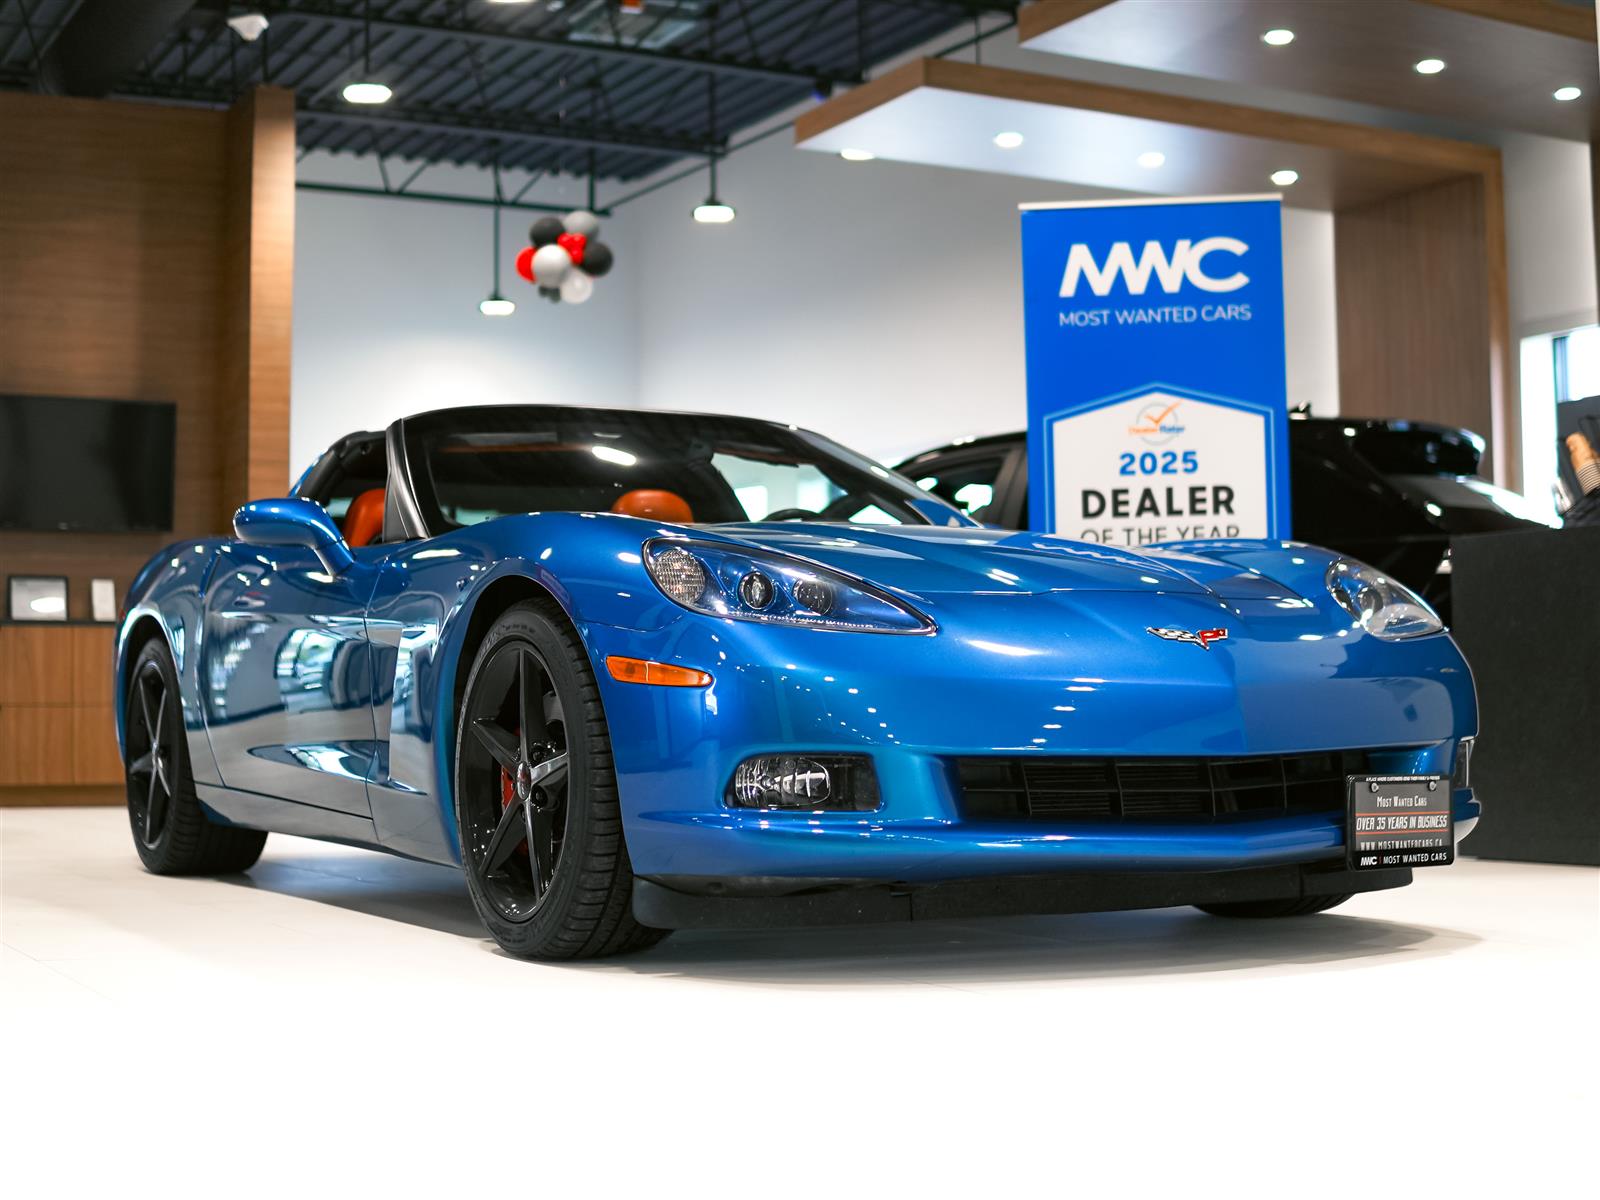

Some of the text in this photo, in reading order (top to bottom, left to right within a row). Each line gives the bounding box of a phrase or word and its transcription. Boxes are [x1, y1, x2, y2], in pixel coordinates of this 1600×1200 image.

[1059, 236, 1250, 298] MWC
[1059, 304, 1252, 327] MOST WANTED CARS
[1119, 450, 1199, 476] 2025
[1081, 485, 1235, 519] DEALER
[1356, 814, 1448, 831] OVER 35 YEARS IN BUSINESS
[1383, 855, 1401, 865] MOST
[1402, 853, 1430, 863] WANTED
[1430, 852, 1448, 862] CARS
